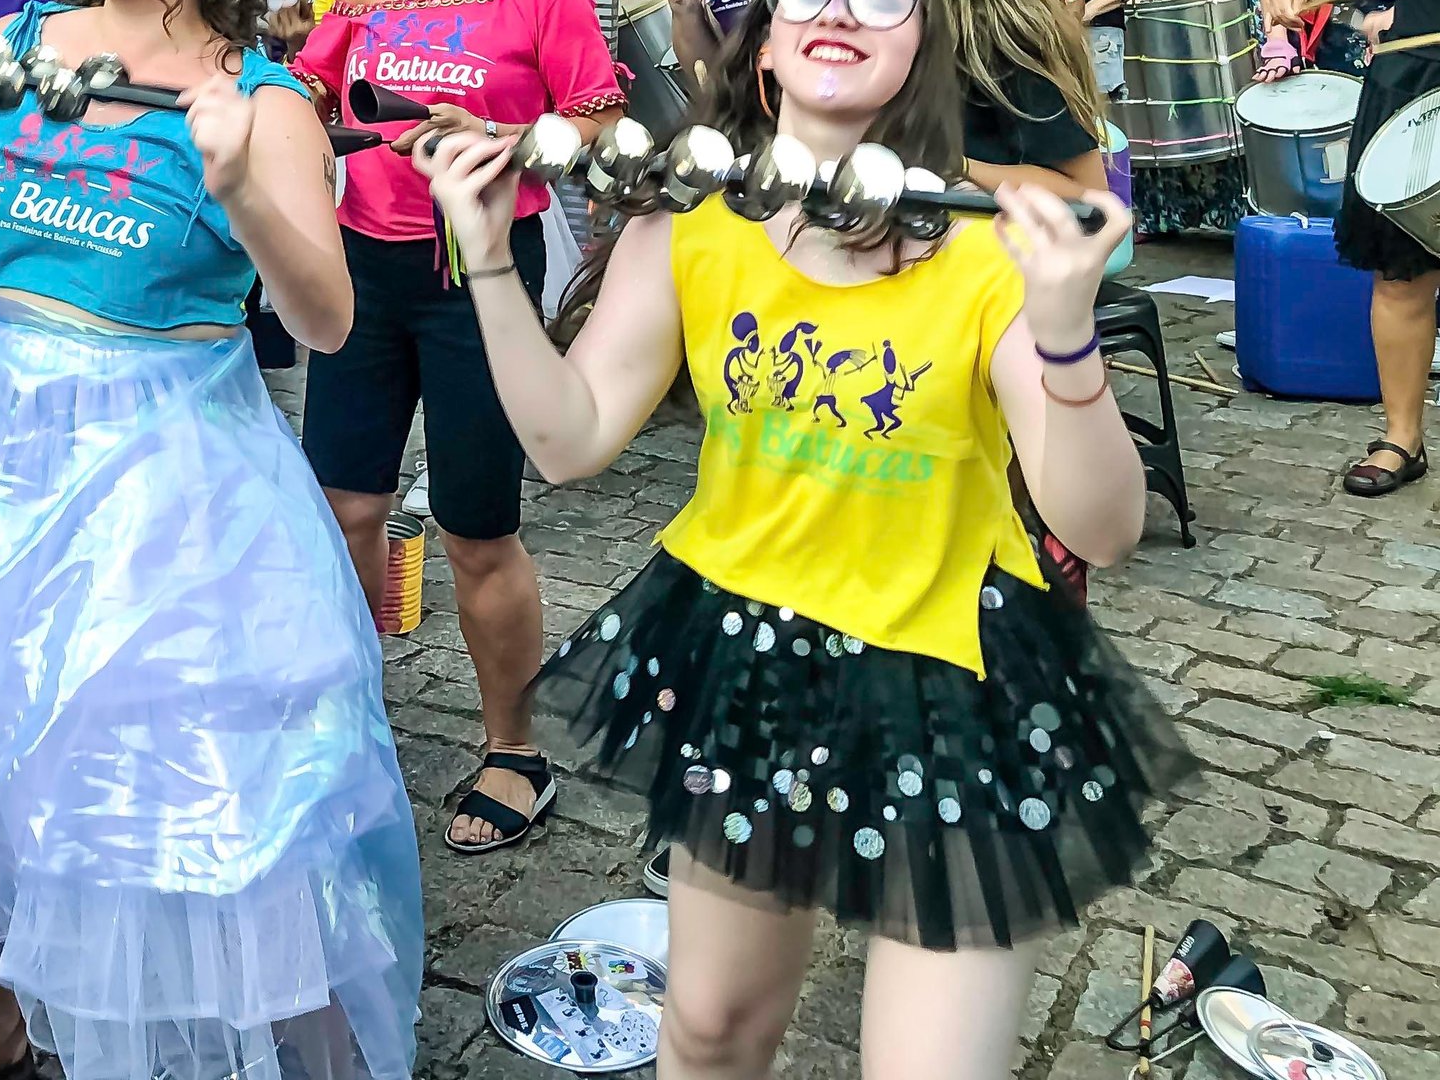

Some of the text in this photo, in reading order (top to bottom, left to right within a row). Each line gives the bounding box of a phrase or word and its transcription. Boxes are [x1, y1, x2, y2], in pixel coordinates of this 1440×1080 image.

[347, 51, 487, 89] As Batucas
[9, 181, 155, 249] Batucas
[12, 222, 43, 237] Feminina
[43, 230, 52, 239] de
[54, 233, 80, 246] Bateria
[86, 240, 123, 258] Percussão
[762, 410, 935, 482] Batucas
